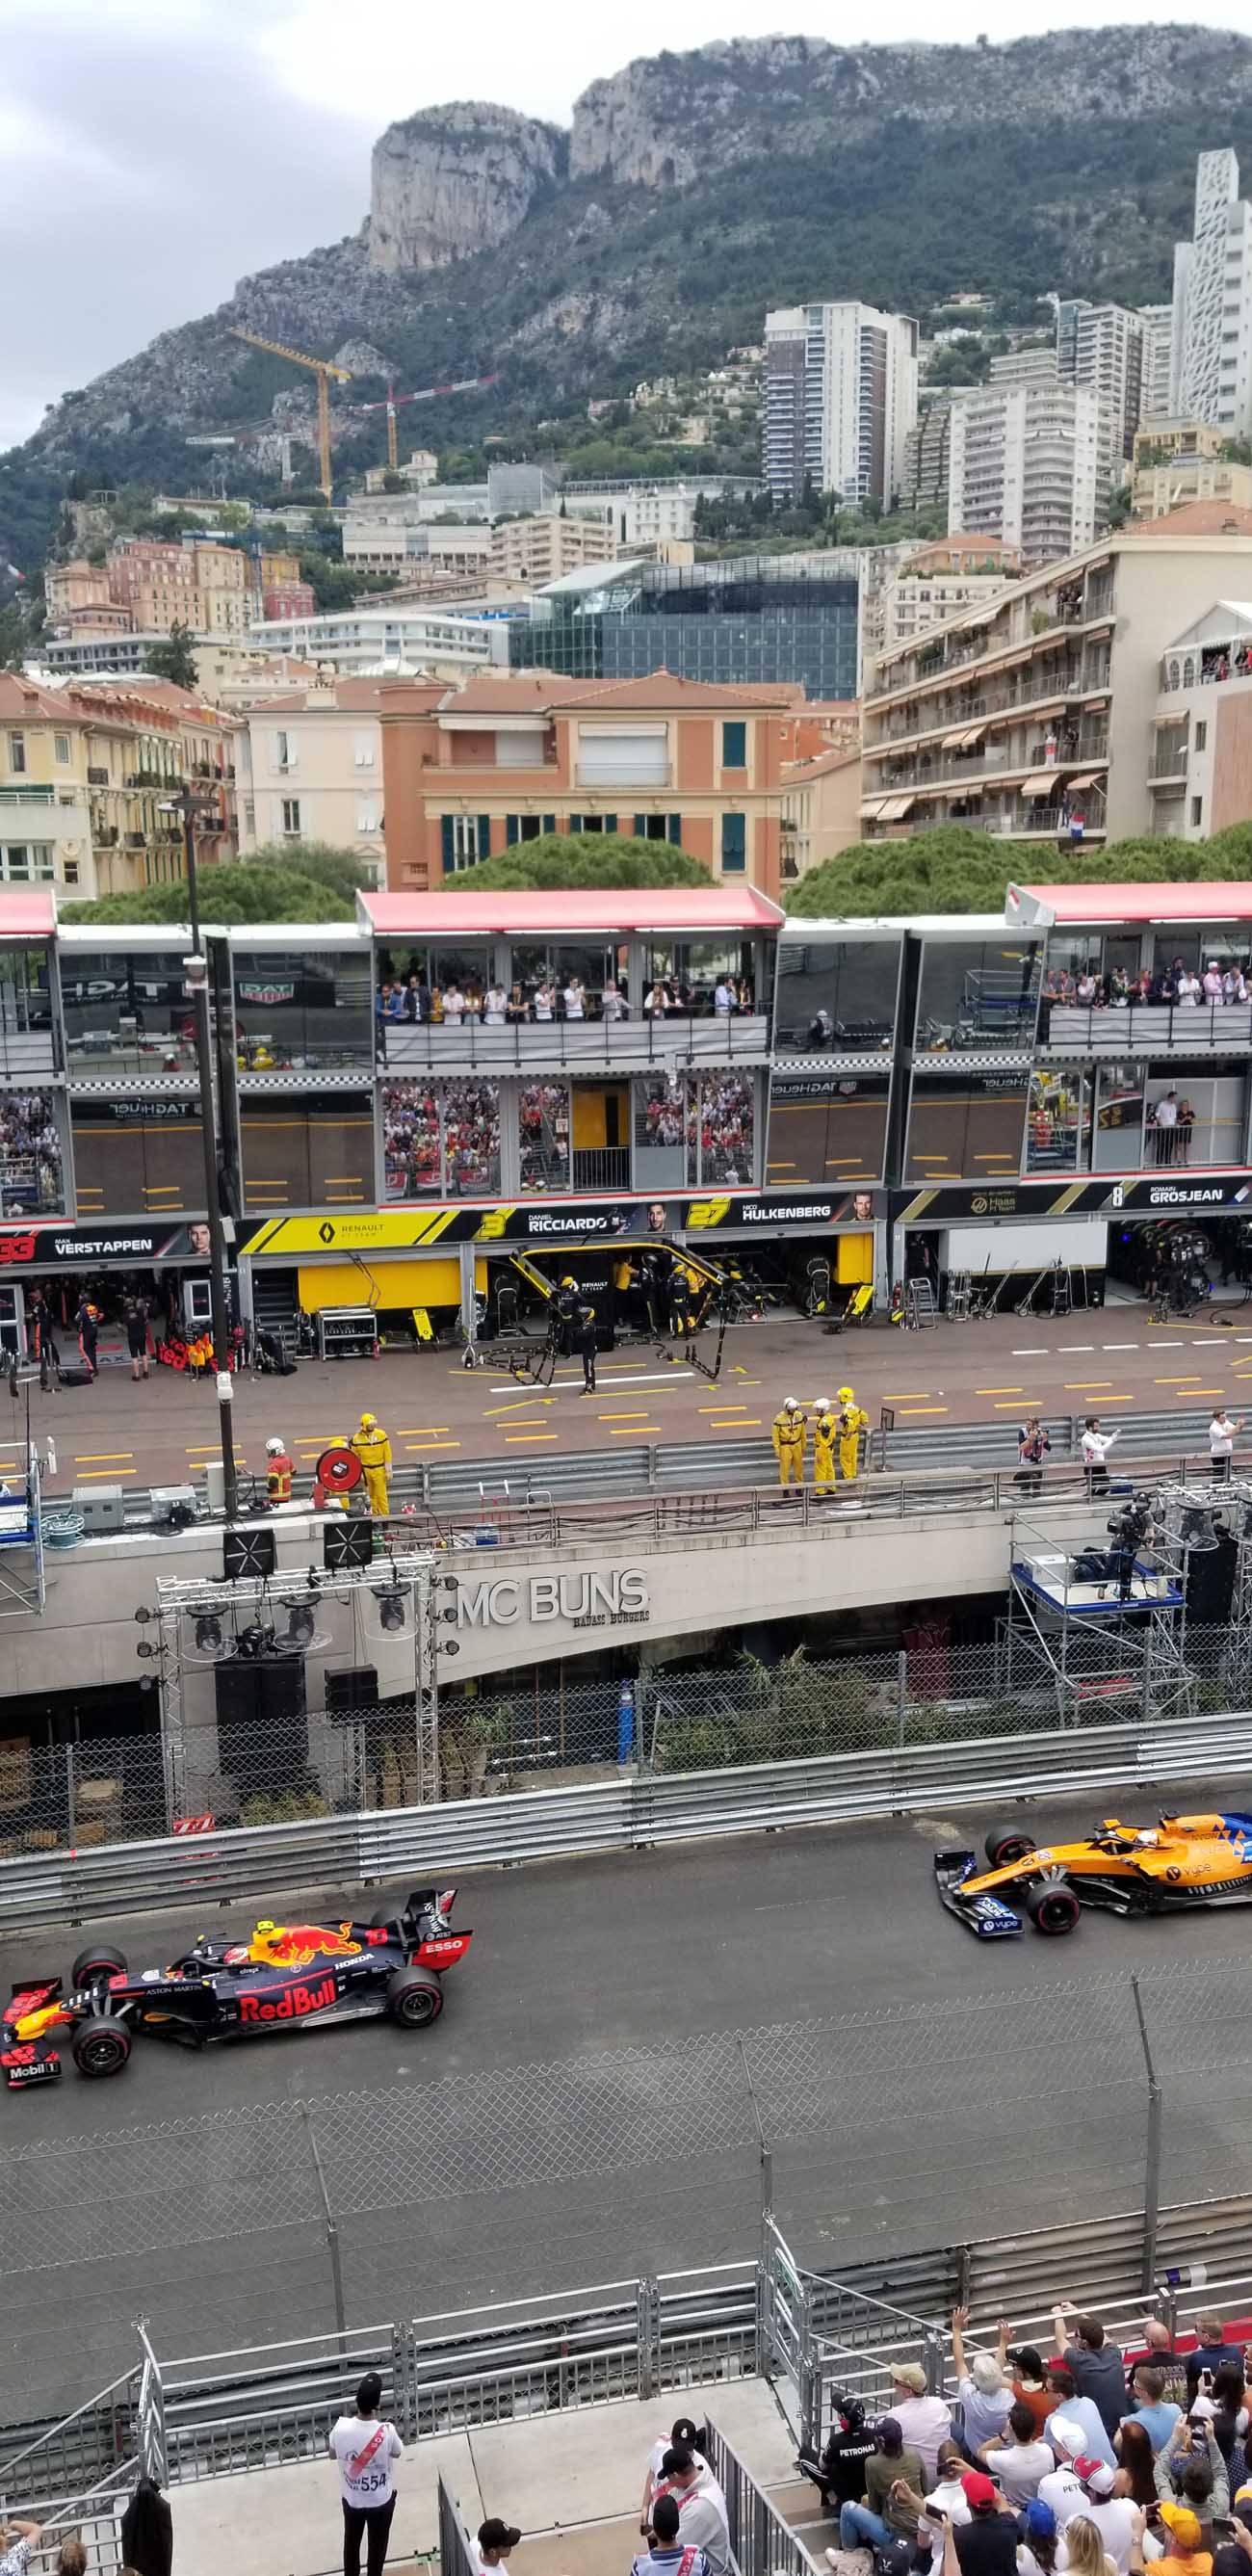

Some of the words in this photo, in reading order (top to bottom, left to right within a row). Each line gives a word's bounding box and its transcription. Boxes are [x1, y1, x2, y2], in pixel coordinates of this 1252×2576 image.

[989, 1196, 1016, 1205] Haas
[1112, 1186, 1123, 1207] 8
[1150, 1189, 1223, 1203] GROSJEAN
[686, 1200, 729, 1229] 27
[742, 1205, 831, 1222] HULKENBERG
[341, 1223, 385, 1232] RENAULT
[480, 1213, 507, 1238] 3
[529, 1217, 608, 1232] RICCIARDO
[55, 1239, 152, 1255] VERSTAPPEN
[456, 1579, 521, 1629] MC
[529, 1567, 649, 1622] BUNS
[573, 1612, 606, 1628] BADASS
[609, 1610, 650, 1624] BURGERS
[995, 1920, 1019, 1930] vype
[426, 1940, 463, 1954] ESSO
[334, 1953, 376, 1971] HONDA
[146, 1986, 172, 1995] ASTON
[173, 1985, 203, 1993] MARTIN
[10, 2063, 45, 2079] Mobil
[839, 2443, 875, 2457] PETRONAS
[1062, 2483, 1080, 2494] PET
